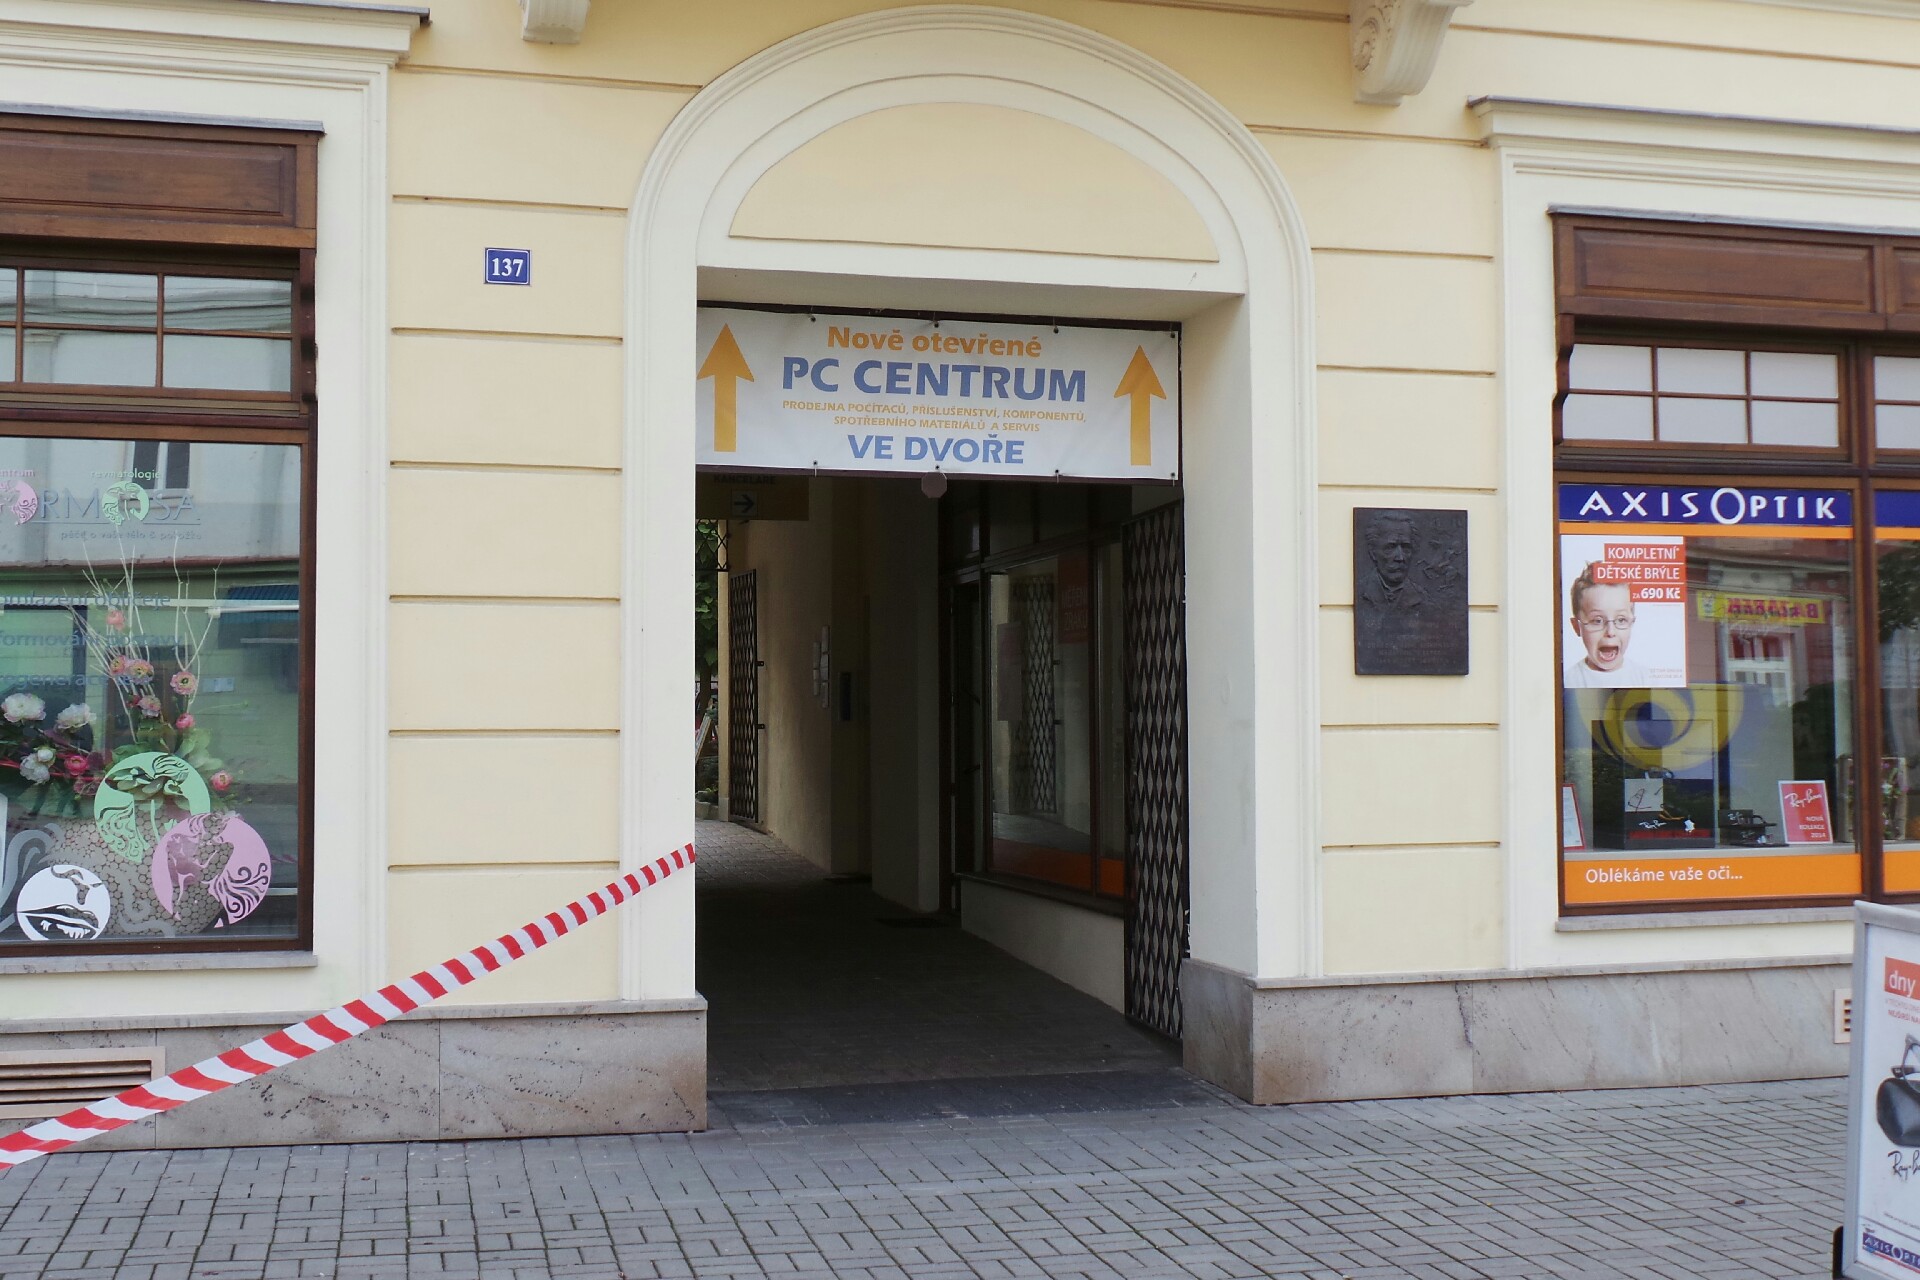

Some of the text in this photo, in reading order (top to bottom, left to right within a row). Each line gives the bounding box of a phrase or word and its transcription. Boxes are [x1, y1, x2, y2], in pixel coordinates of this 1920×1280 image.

[492, 258, 524, 277] 137
[827, 325, 1042, 358] Nově otevřené
[782, 356, 1086, 403] PC CENTRUM
[782, 400, 846, 411] PRODEJNA
[833, 414, 917, 428] SPOTŘEBNÍHO
[991, 422, 999, 431] A
[1002, 422, 1041, 432] SERVIS
[847, 433, 1025, 464] VE DVOŘE
[1597, 565, 1680, 580] DĚTSKÉ BRÝLE
[1641, 588, 1664, 599] 690
[1666, 588, 1681, 599] Kč
[1784, 788, 1823, 808] Ray-Ban
[1585, 867, 1665, 883] Oblékáme
[1669, 866, 1704, 881] vaše
[1889, 970, 1916, 998] dny
